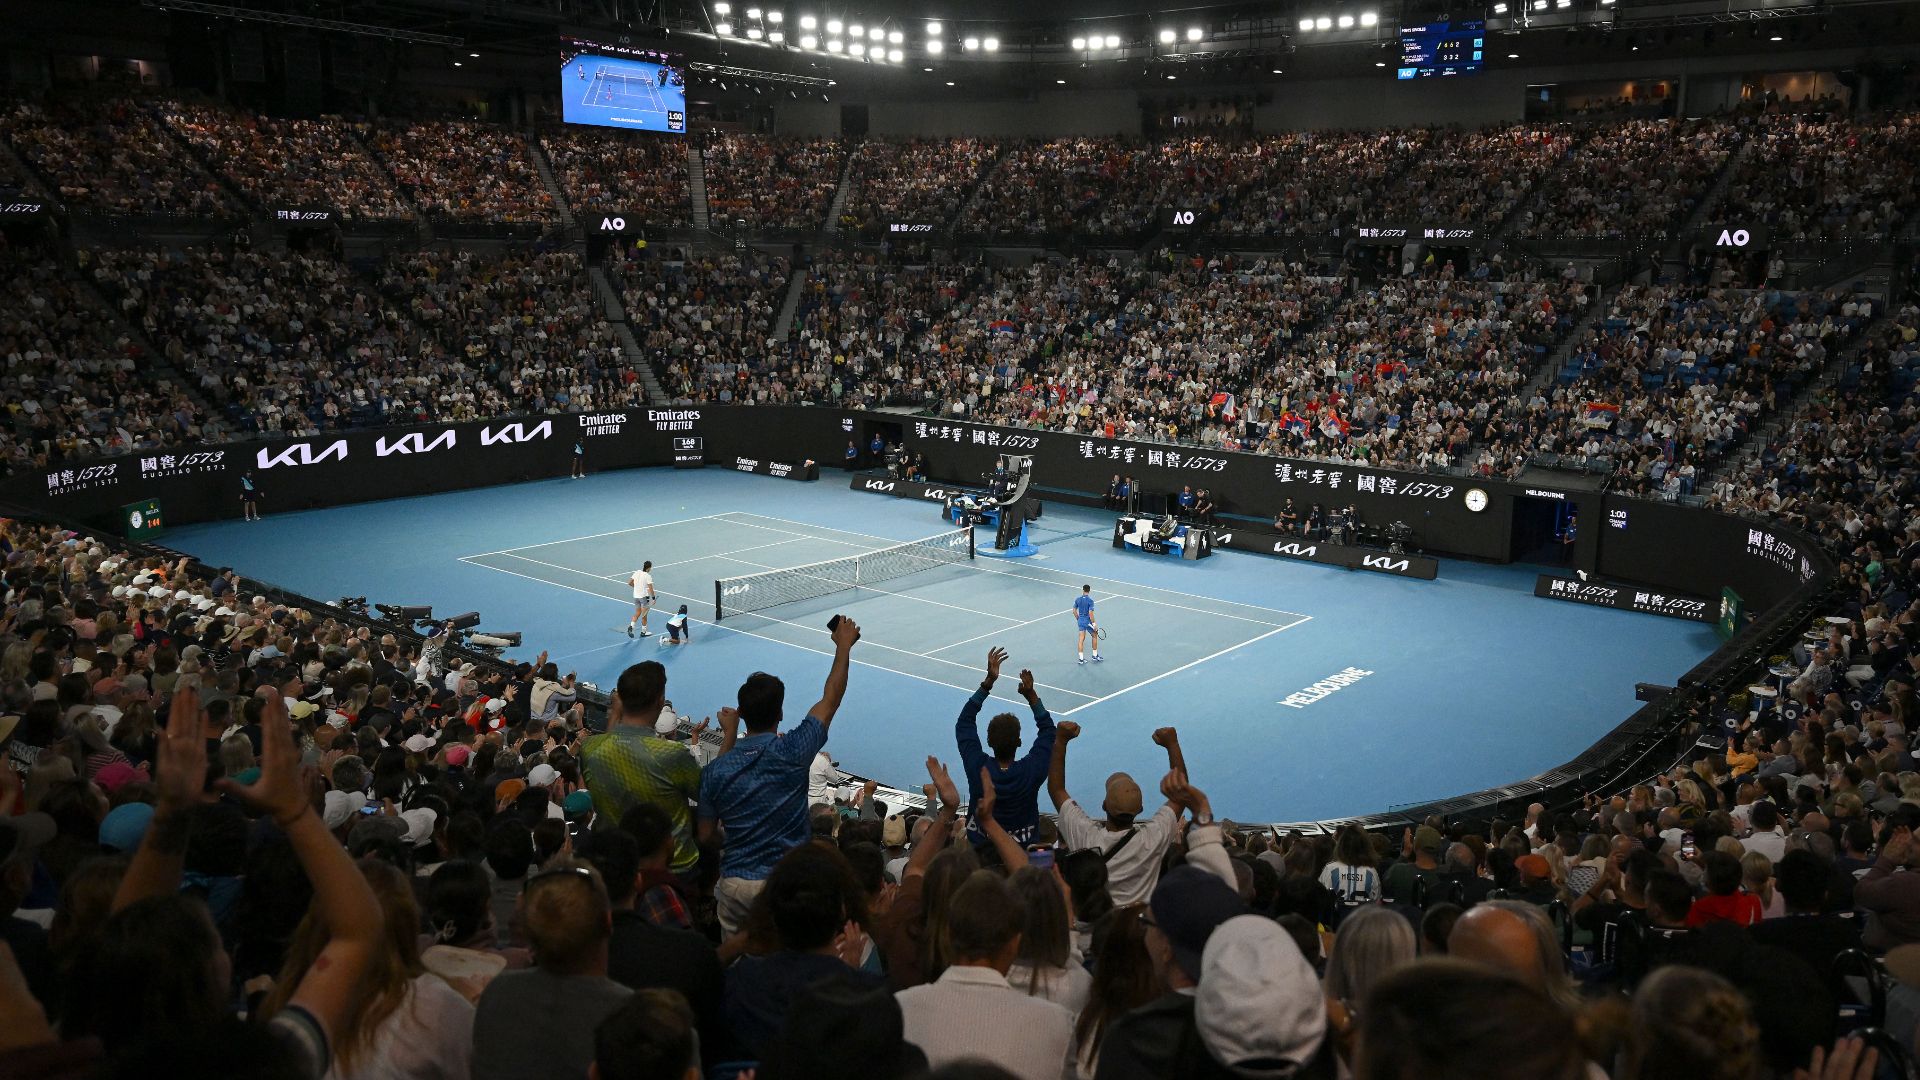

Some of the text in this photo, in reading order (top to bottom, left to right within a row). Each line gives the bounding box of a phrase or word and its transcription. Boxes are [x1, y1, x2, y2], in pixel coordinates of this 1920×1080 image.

[668, 112, 683, 121] 1:00
[600, 217, 626, 231] AO
[1173, 211, 1195, 225] AO
[1715, 229, 1750, 247] AO
[578, 413, 627, 427] Emirates
[648, 409, 701, 421] Emirates
[586, 424, 620, 437] FLY BETTER
[656, 420, 693, 431] FLY BETTER
[480, 420, 552, 446] KIA
[375, 429, 457, 457] KIA
[681, 438, 696, 446] 168
[257, 439, 348, 469] KIA
[142, 468, 191, 479] GUOJIAO
[865, 479, 895, 491] KIA
[1525, 489, 1565, 500] MELBOURNE
[1609, 509, 1627, 519] 1:00
[147, 518, 160, 528] 1:44
[1273, 541, 1317, 557] KIA
[1362, 554, 1410, 571] KIA
[723, 583, 750, 597] KIA
[1276, 666, 1375, 709] MELBOURNE
[1341, 873, 1363, 882] MESSI
